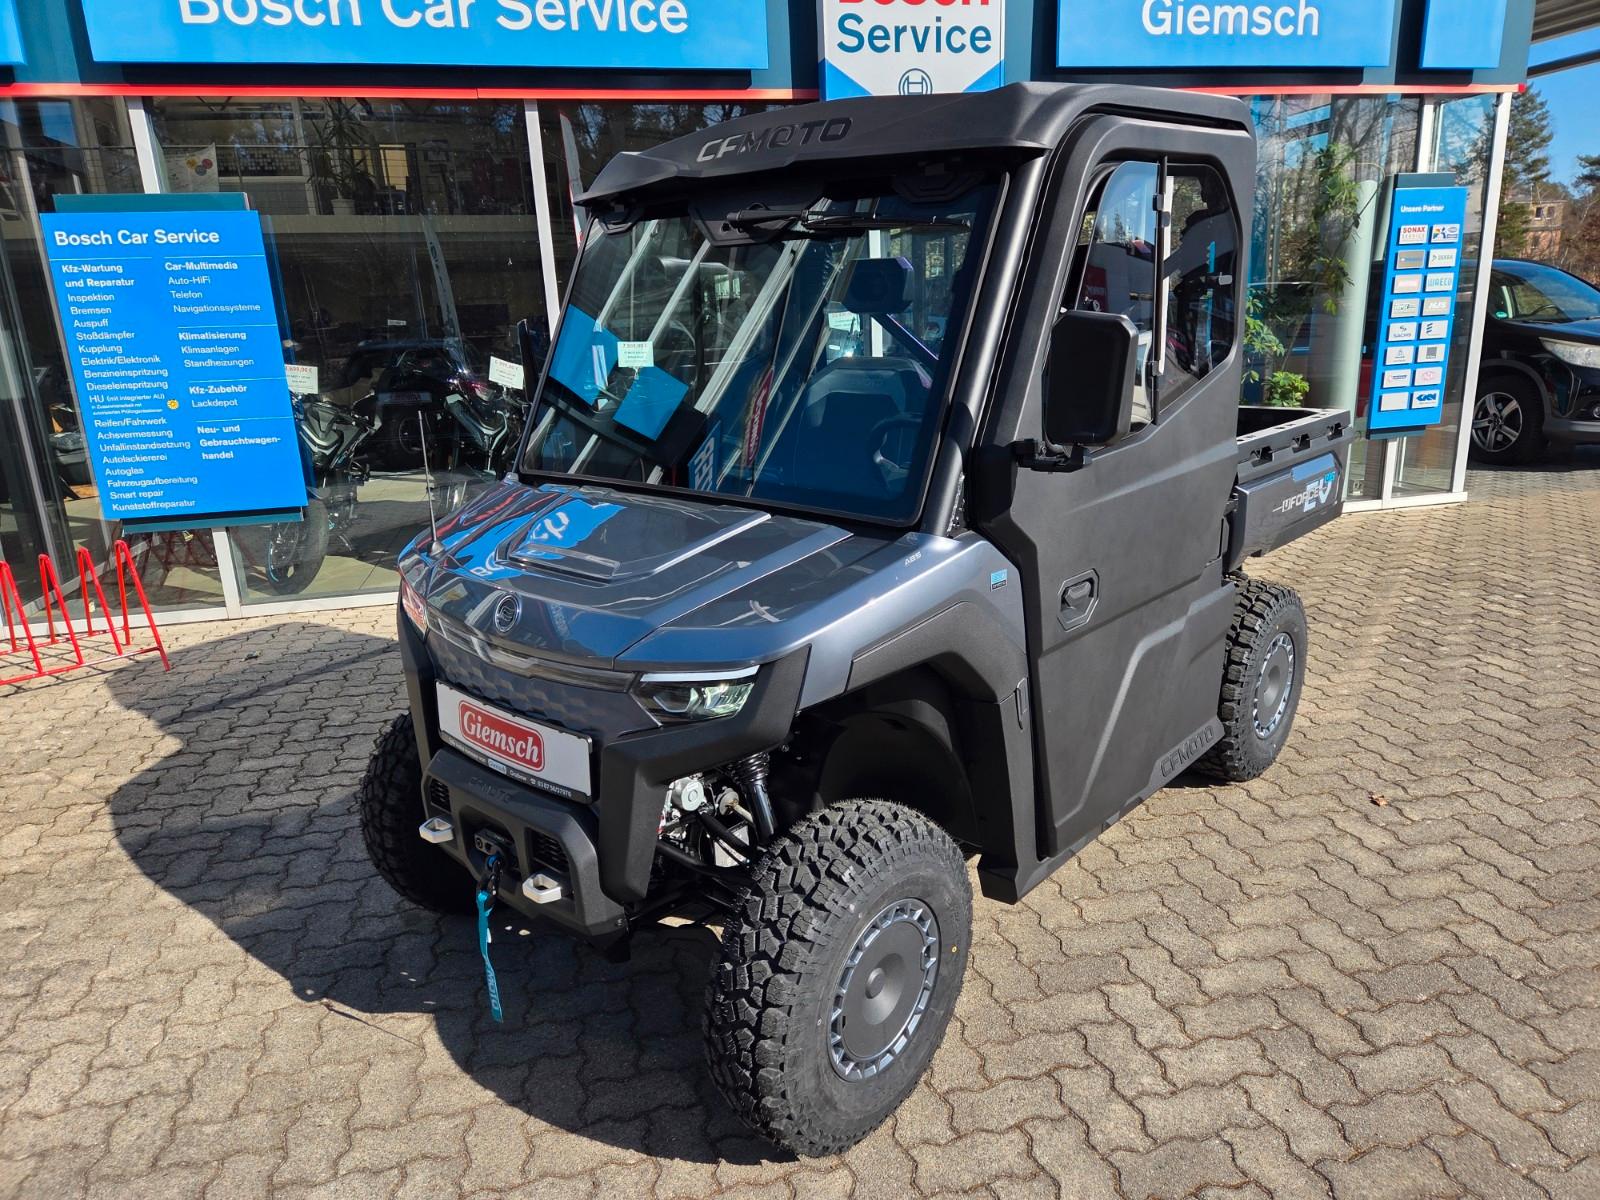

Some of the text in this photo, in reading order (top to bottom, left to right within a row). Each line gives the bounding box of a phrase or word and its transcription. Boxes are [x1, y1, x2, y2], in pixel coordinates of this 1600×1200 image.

[381, 0, 475, 28] Car
[496, 0, 689, 34] Service
[1141, 0, 1319, 36] Giemsch
[837, 13, 992, 54] Service
[696, 117, 853, 162] CFMOTO
[1400, 205, 1422, 213] Unsere
[54, 229, 220, 246] Bosch Car Service
[62, 265, 124, 274] Kfz-Wartung
[165, 262, 239, 271] Car-Multimedia
[65, 279, 135, 288] und Reparatur
[169, 276, 211, 285] Auto-HiFi
[68, 294, 115, 304] Inspektion
[170, 291, 203, 299] Telefon
[70, 307, 112, 315] Bremsen
[174, 305, 261, 315] Navigationssysteme
[74, 319, 109, 329] Auspuff
[76, 331, 135, 341] Stoßdämpfer
[179, 332, 247, 341] Klimatisierung
[79, 345, 123, 355] Kupplung
[182, 346, 240, 355] Klimaanlagen
[82, 355, 161, 366] Elektrik/Elektronik
[184, 359, 254, 368] Standheizungen
[84, 369, 169, 379] Benzineinspritzung
[87, 381, 169, 391] Dieseleinspritzung
[189, 385, 248, 395] Kfz-Zubehör
[90, 395, 105, 403] HU
[192, 399, 238, 408] Lackdepot
[94, 417, 167, 428] Reifen/Fahrwerk
[197, 425, 241, 434] Neu- und
[98, 431, 174, 440] Achsvermessung
[100, 442, 191, 452] Unfallinstandsetzung
[200, 437, 281, 448] Gebrauchtwagen-
[103, 455, 168, 464] Autolackiererei
[202, 451, 234, 460] handel
[106, 467, 145, 477] Autoglas
[108, 475, 198, 488] Fahrzeugaufbereitung
[110, 491, 164, 500] Smart repair
[112, 498, 196, 511] Kunststoffreparatur
[463, 711, 539, 763] Giemsch
[1160, 726, 1214, 777] CFMOTO
